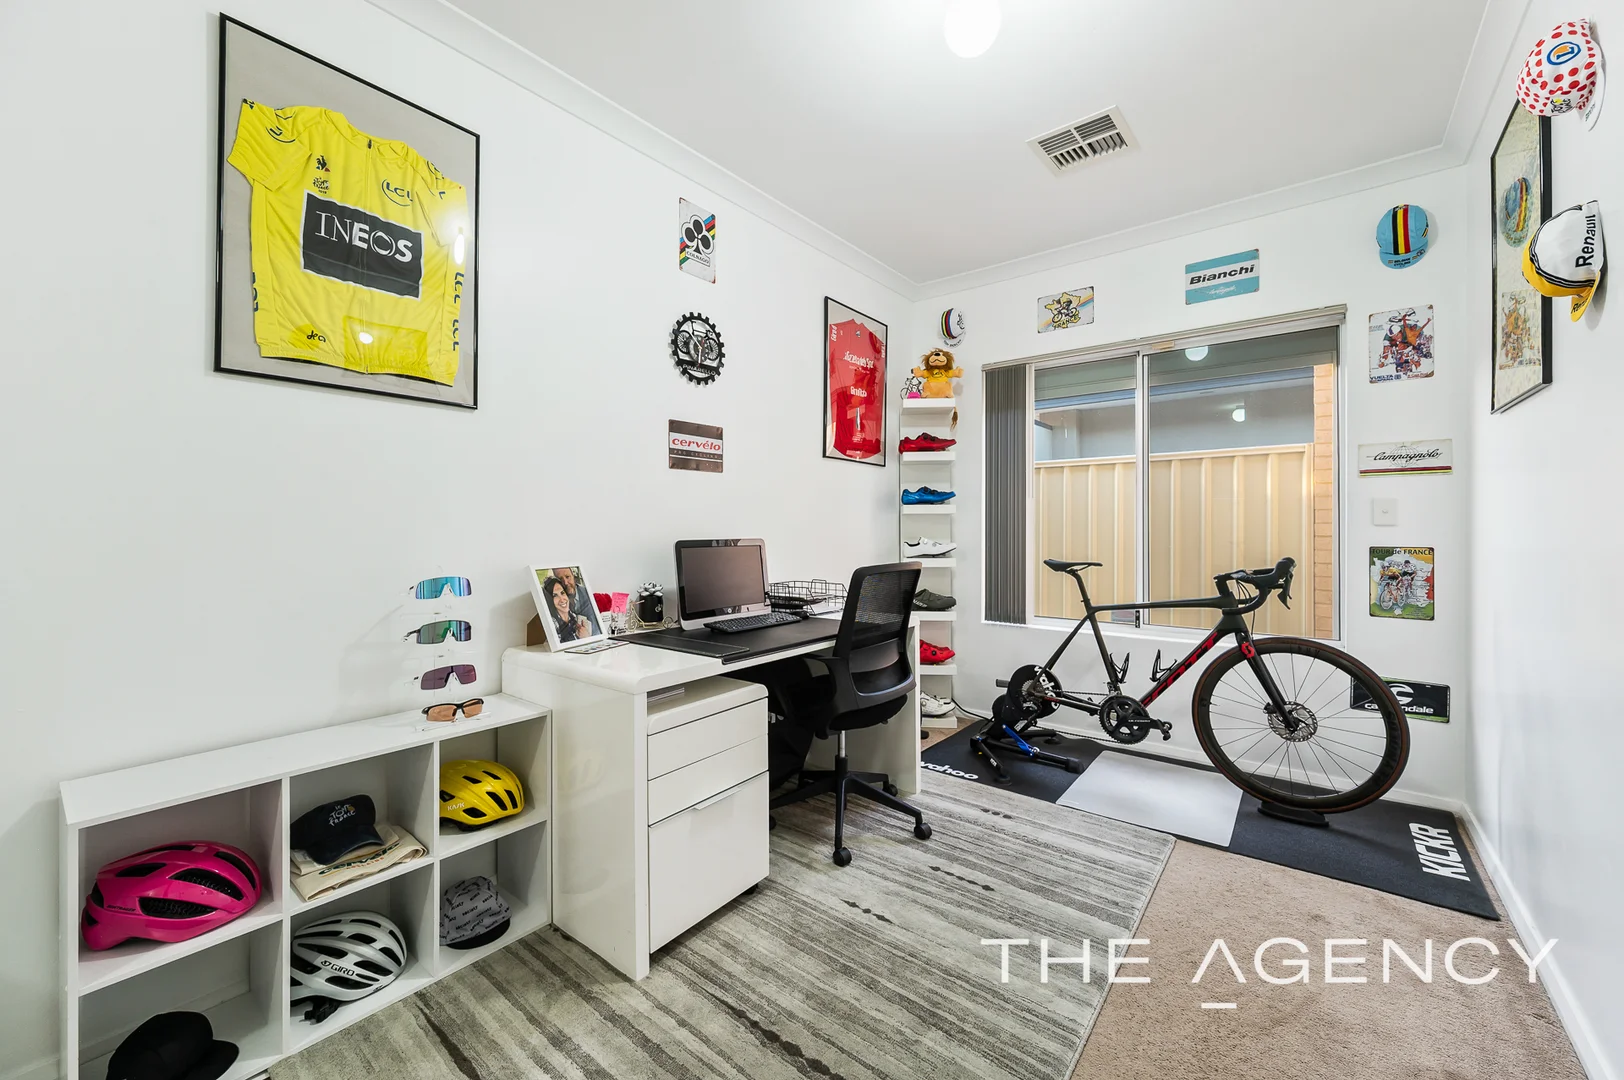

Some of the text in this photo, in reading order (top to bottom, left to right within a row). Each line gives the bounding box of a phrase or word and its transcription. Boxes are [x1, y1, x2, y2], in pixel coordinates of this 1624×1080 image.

[315, 211, 413, 263] INEOS
[1190, 264, 1255, 285] Bianchi
[672, 438, 721, 450] cervélo
[1408, 822, 1471, 882] KICKR
[330, 963, 355, 976] GIRO
